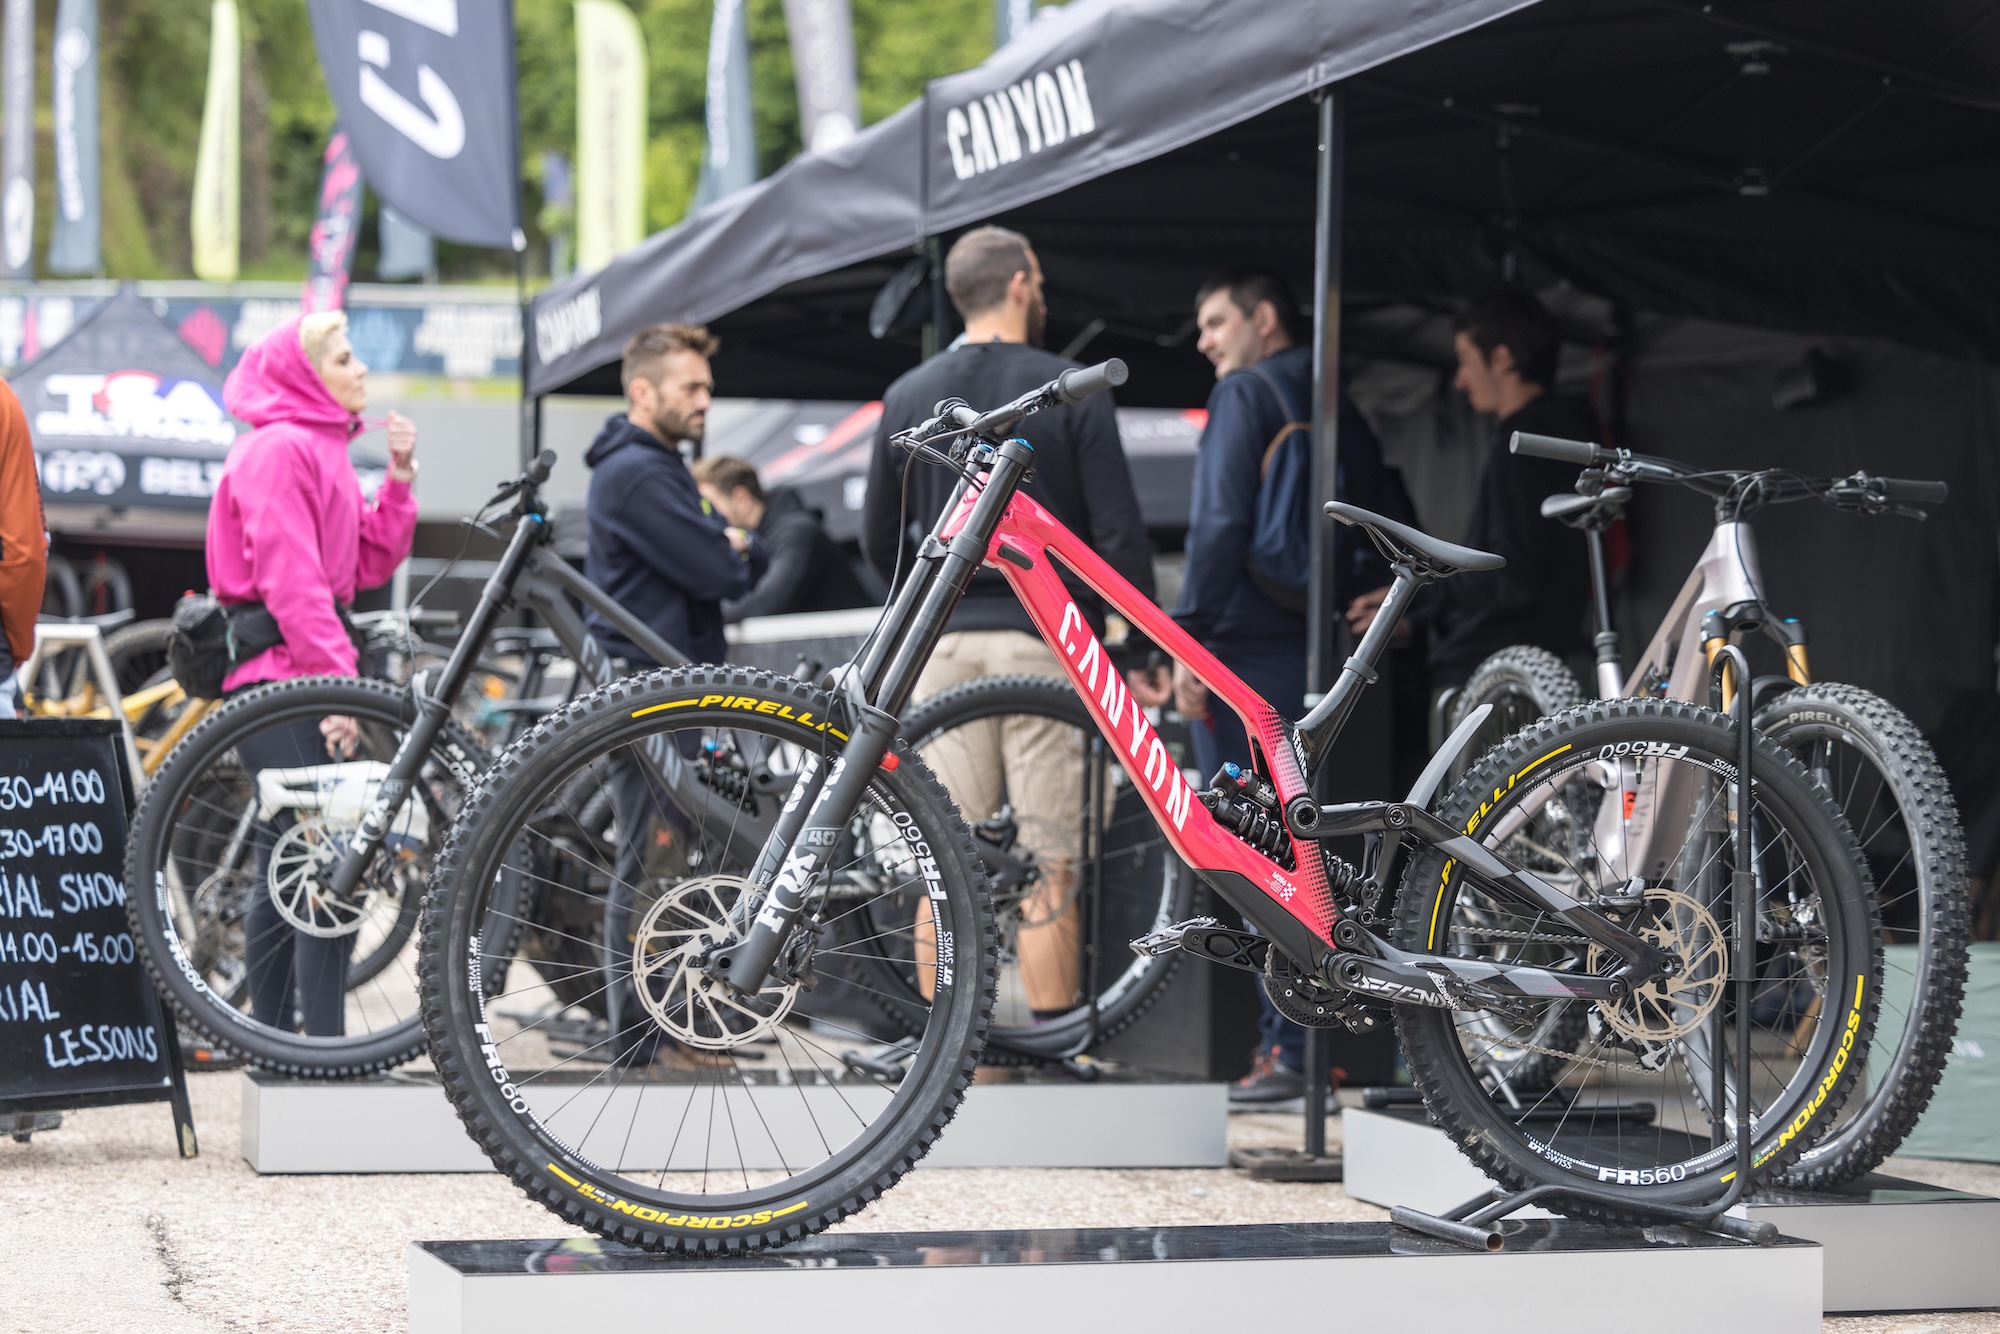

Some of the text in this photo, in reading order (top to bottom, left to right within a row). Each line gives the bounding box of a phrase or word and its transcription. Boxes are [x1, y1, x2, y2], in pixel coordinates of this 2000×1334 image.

[946, 59, 1096, 180] CANYON
[698, 694, 832, 732] PIRELLI
[1058, 600, 1191, 832] CANYON
[1788, 711, 1852, 729] PIRELLI
[1598, 741, 1690, 761] FR560
[350, 798, 397, 855] FOX
[807, 830, 837, 847] 40
[892, 811, 949, 901] FR560
[755, 845, 821, 934] FOX
[162, 929, 208, 993] FR560
[469, 935, 478, 992] DT SWISS
[943, 930, 954, 987] DT SWISS
[45, 1024, 160, 1069] LESSONS
[475, 1022, 529, 1115] FR560
[1779, 1008, 1862, 1149] SCORPION
[1527, 1140, 1573, 1170] DT SWISS
[1597, 1164, 1687, 1186] FR560
[612, 1199, 774, 1230] SCORPION
